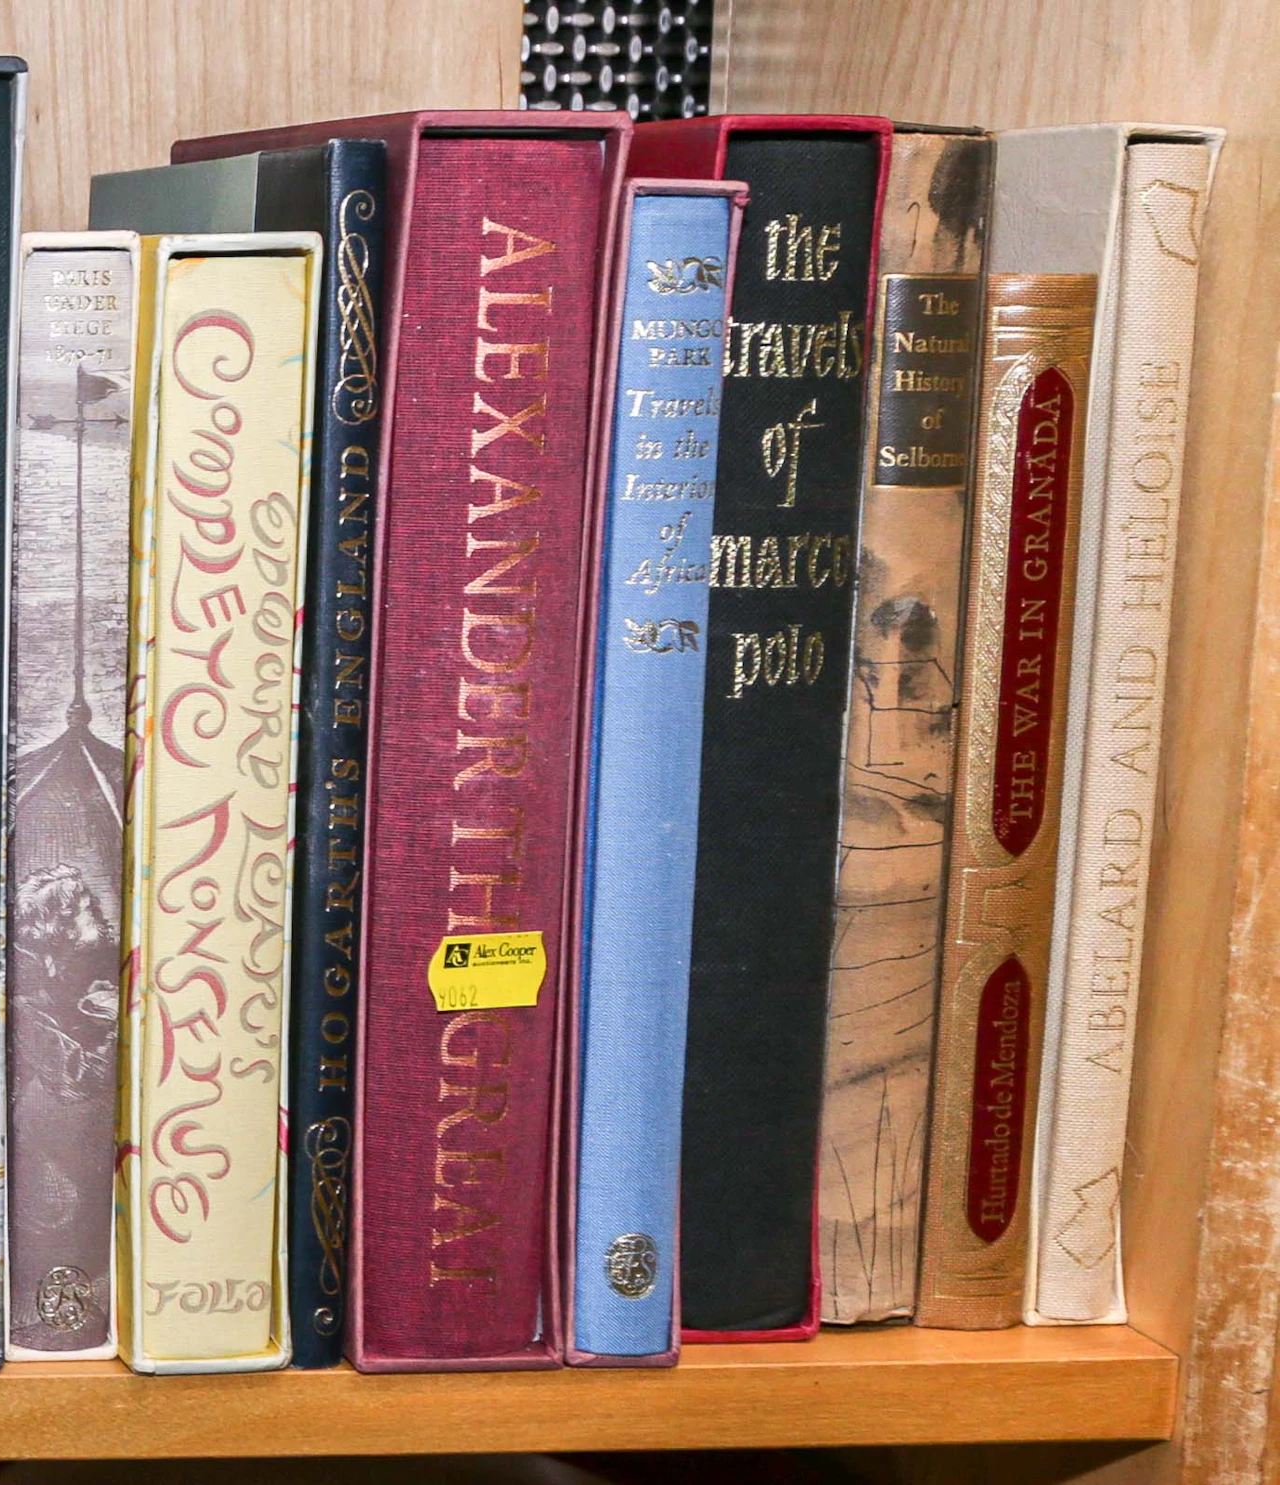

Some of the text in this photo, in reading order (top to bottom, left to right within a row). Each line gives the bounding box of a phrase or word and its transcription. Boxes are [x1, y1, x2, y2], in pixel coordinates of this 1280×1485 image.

[762, 212, 841, 283] the
[51, 269, 114, 287] PARIS
[44, 294, 118, 312] UNDER
[918, 292, 960, 316] The
[50, 319, 114, 338] SIEGE
[723, 310, 864, 379] travels
[893, 331, 972, 354] Natural
[647, 347, 713, 369] PARK
[893, 369, 966, 398] History
[920, 409, 945, 430] of
[635, 430, 710, 460] in the
[760, 397, 826, 508] of
[620, 472, 715, 502] Interio
[658, 511, 693, 551] of
[624, 552, 708, 596] Africa
[708, 531, 851, 589] marco
[1008, 394, 1063, 826] THE WAR IN GRANADA
[727, 623, 825, 700] polo
[1110, 645, 1160, 776] AND
[319, 445, 370, 1092] HOGARTH'S ENGLAND
[429, 216, 557, 1297] ALEXANDER TH GREAT
[474, 941, 537, 960] Alex Cooper
[1085, 808, 1144, 1074] ABELARD
[980, 980, 1021, 1225] Hurtado de Mendoza
